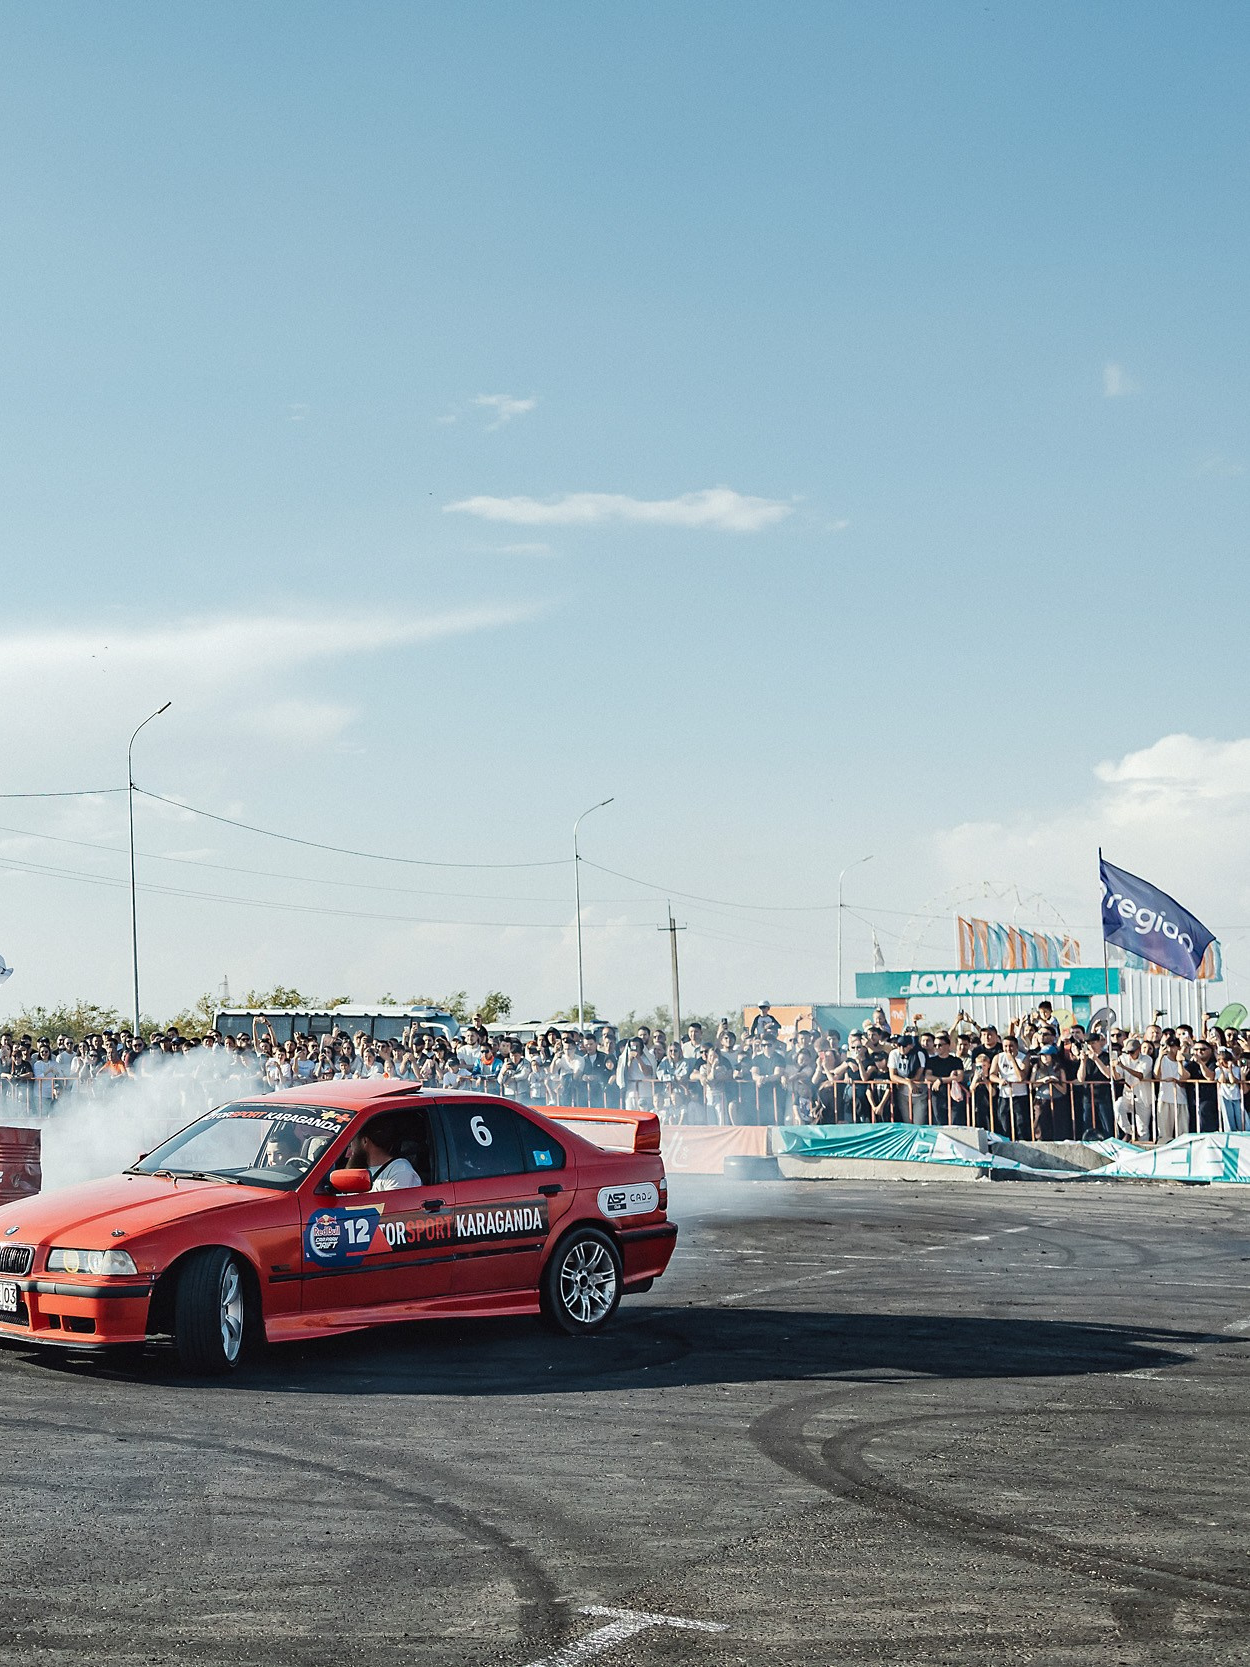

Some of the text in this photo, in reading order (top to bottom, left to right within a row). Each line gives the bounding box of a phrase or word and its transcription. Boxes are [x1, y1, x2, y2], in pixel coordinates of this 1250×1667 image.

[1106, 892, 1194, 953] region
[264, 1111, 342, 1133] KARAGANDA
[470, 1115, 493, 1147] 6
[344, 1218, 370, 1244] 12
[378, 1207, 543, 1246] TORSPORT KARAGANDA
[3, 1287, 16, 1304] 03
